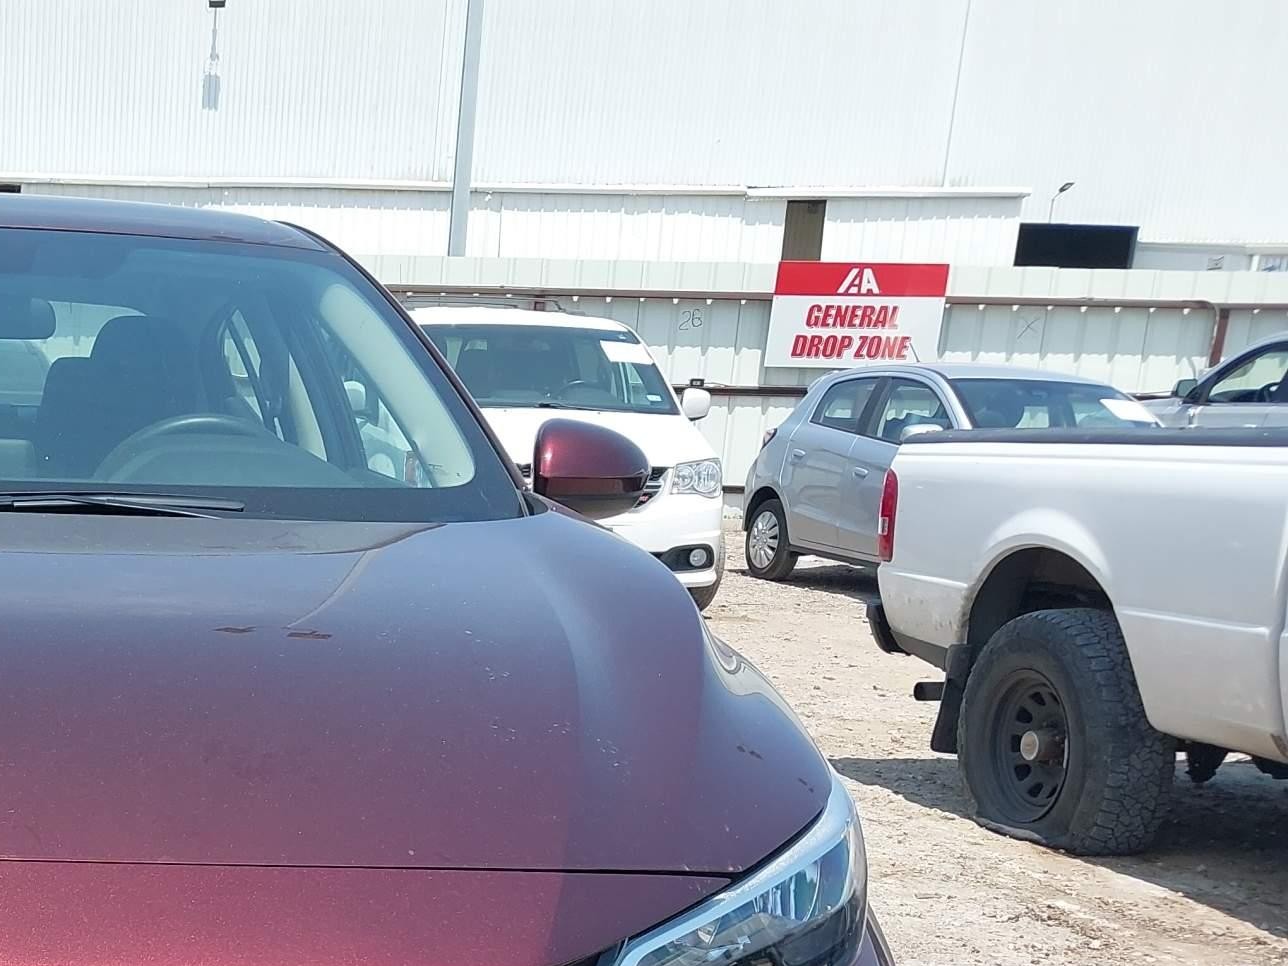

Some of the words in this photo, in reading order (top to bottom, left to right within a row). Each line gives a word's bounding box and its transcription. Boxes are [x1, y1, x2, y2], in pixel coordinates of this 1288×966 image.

[678, 308, 703, 331] 26
[805, 304, 899, 329] GENERAL
[790, 334, 855, 359] DROP
[853, 335, 911, 360] ZONE
